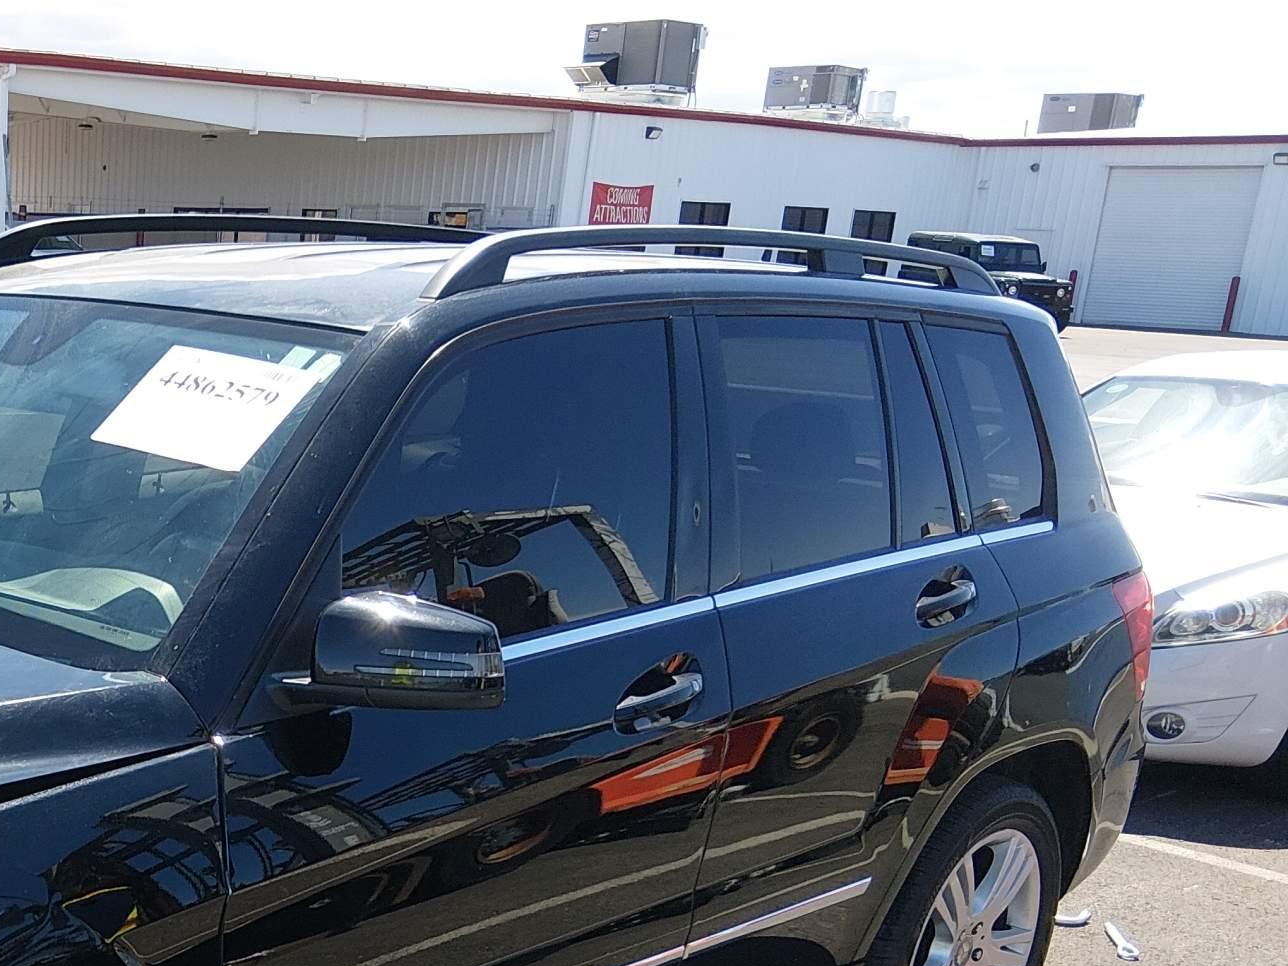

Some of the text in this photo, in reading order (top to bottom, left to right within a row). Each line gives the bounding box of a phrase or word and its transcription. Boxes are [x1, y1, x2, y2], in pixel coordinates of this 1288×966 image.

[607, 187, 640, 205] COMING
[593, 204, 649, 224] ATTRACTIONS
[159, 370, 280, 406] 44862579
